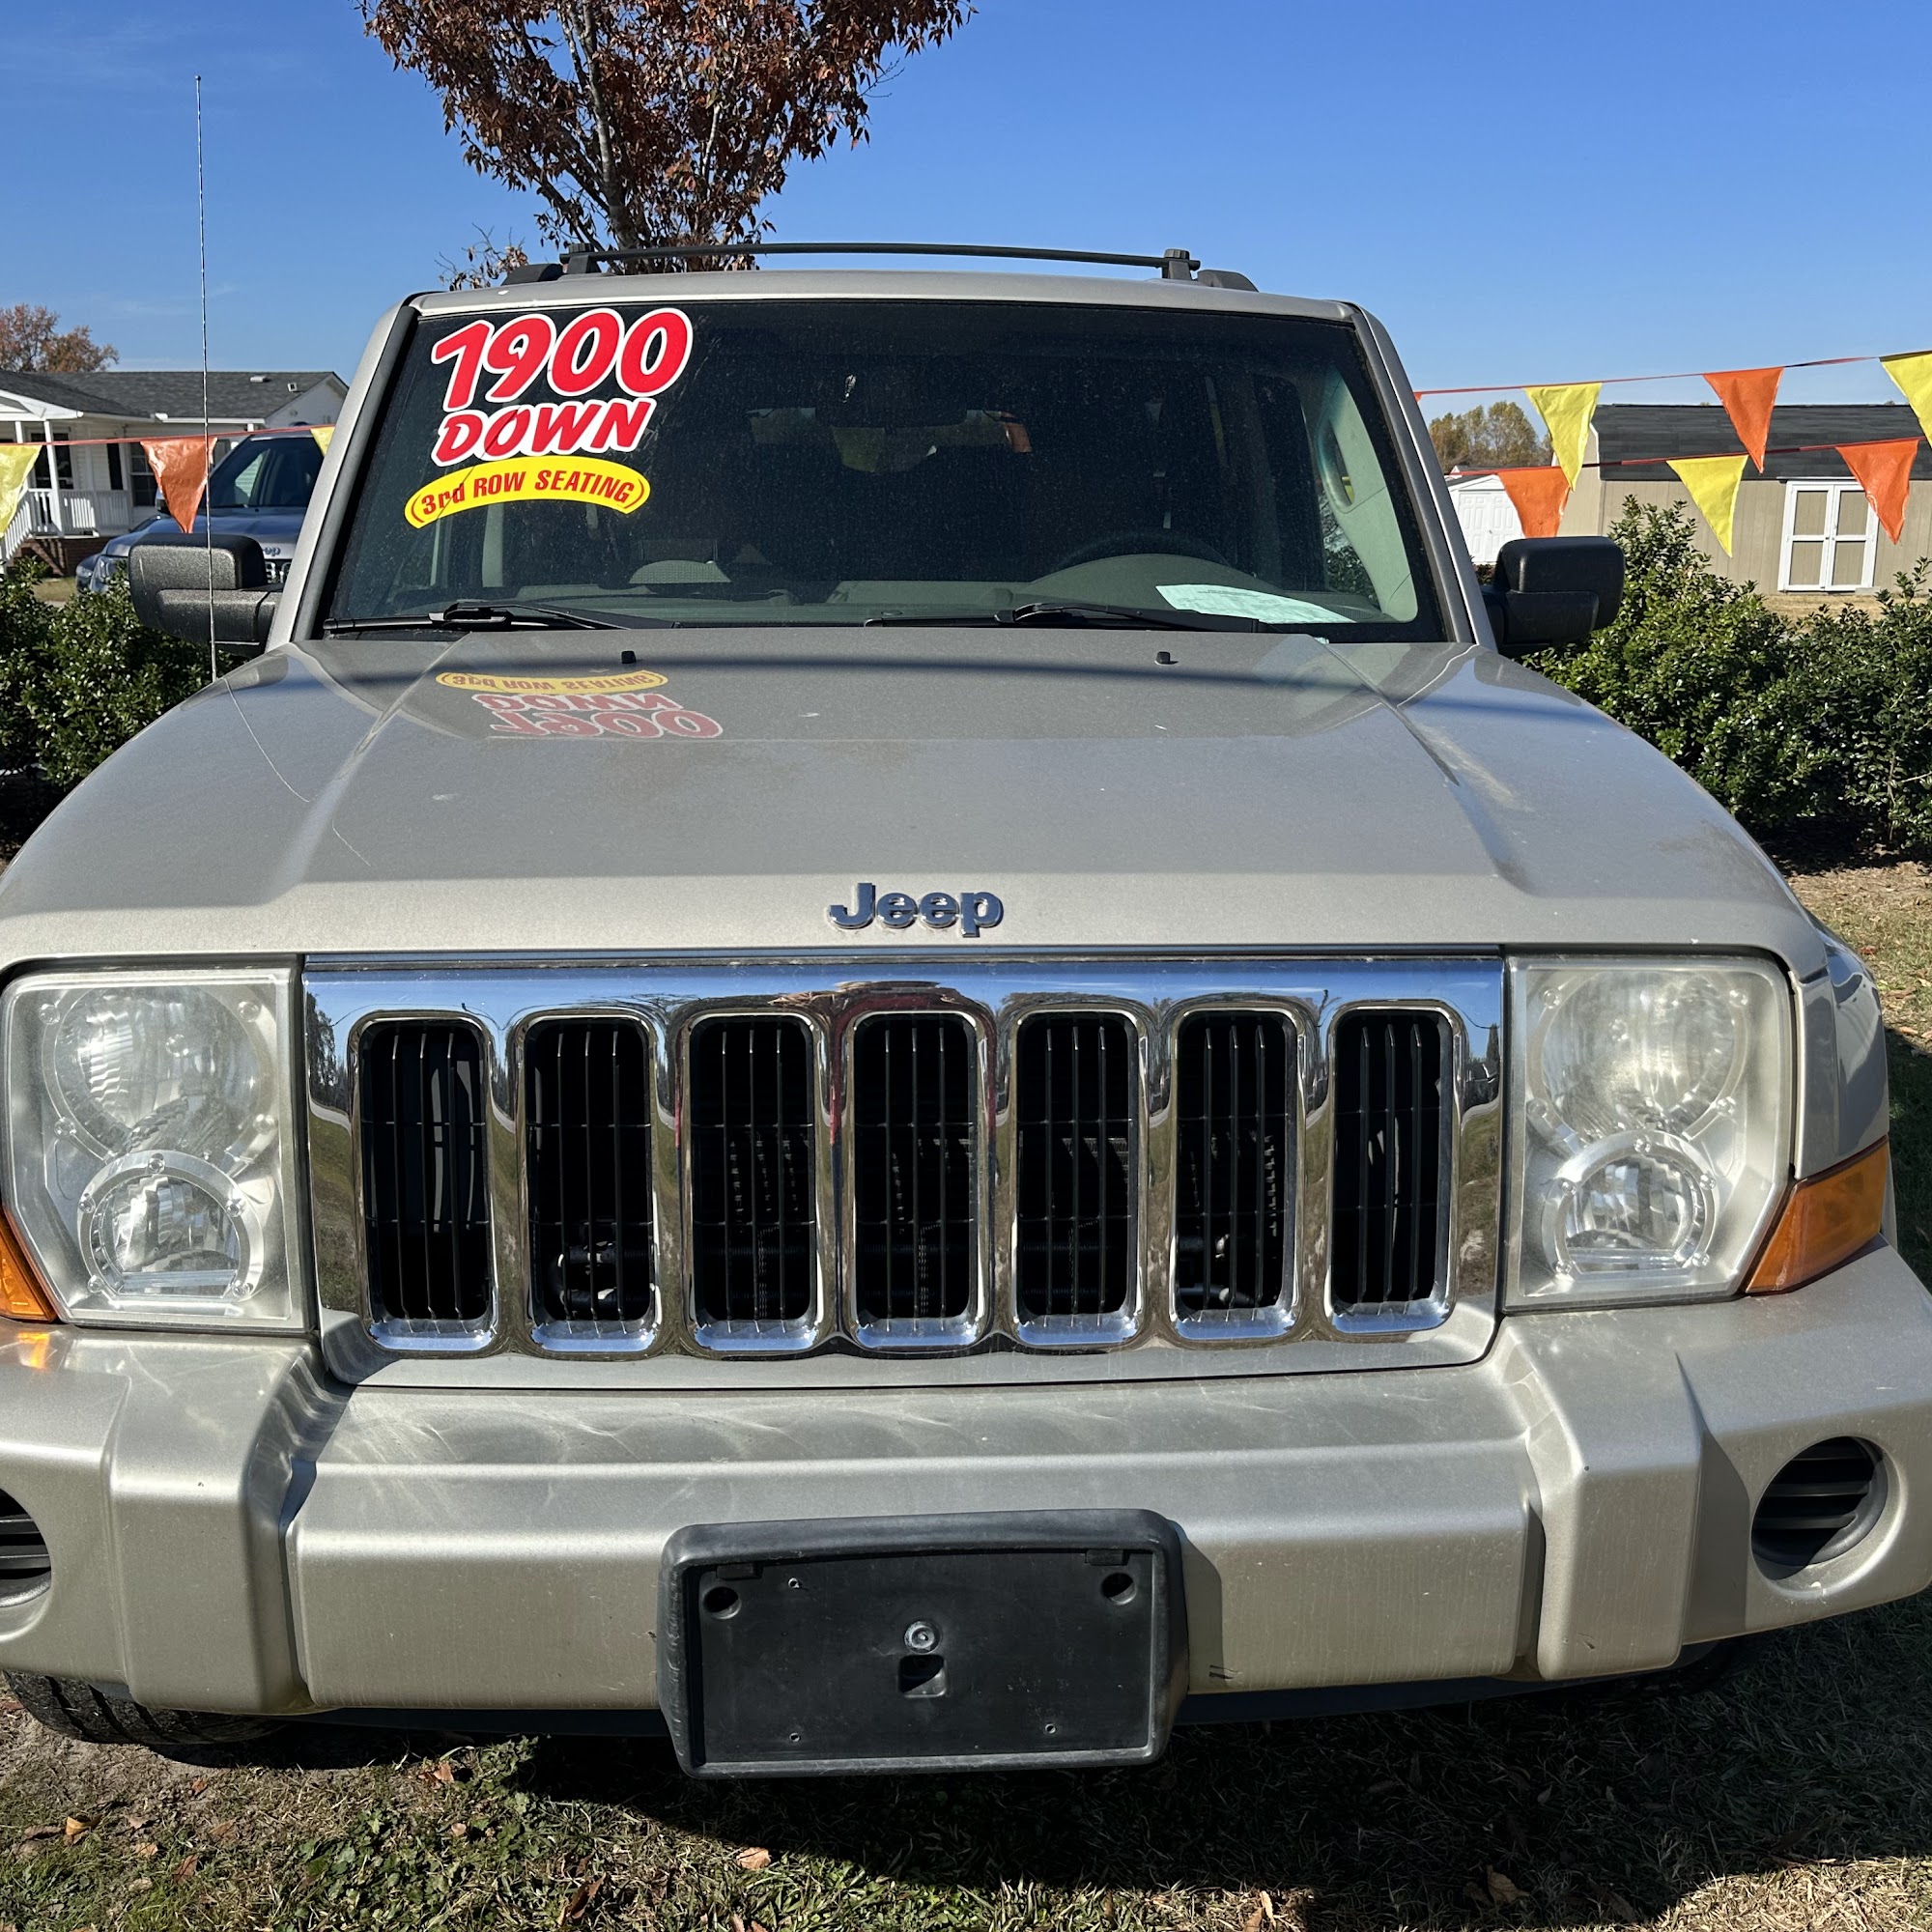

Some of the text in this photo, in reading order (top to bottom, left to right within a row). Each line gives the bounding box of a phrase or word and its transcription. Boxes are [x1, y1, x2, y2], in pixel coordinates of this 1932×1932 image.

[432, 308, 693, 412] 1900
[432, 397, 657, 467] DOWN
[473, 471, 526, 498] ROW
[534, 469, 635, 503] SEATING
[829, 882, 1005, 938] Jeep
